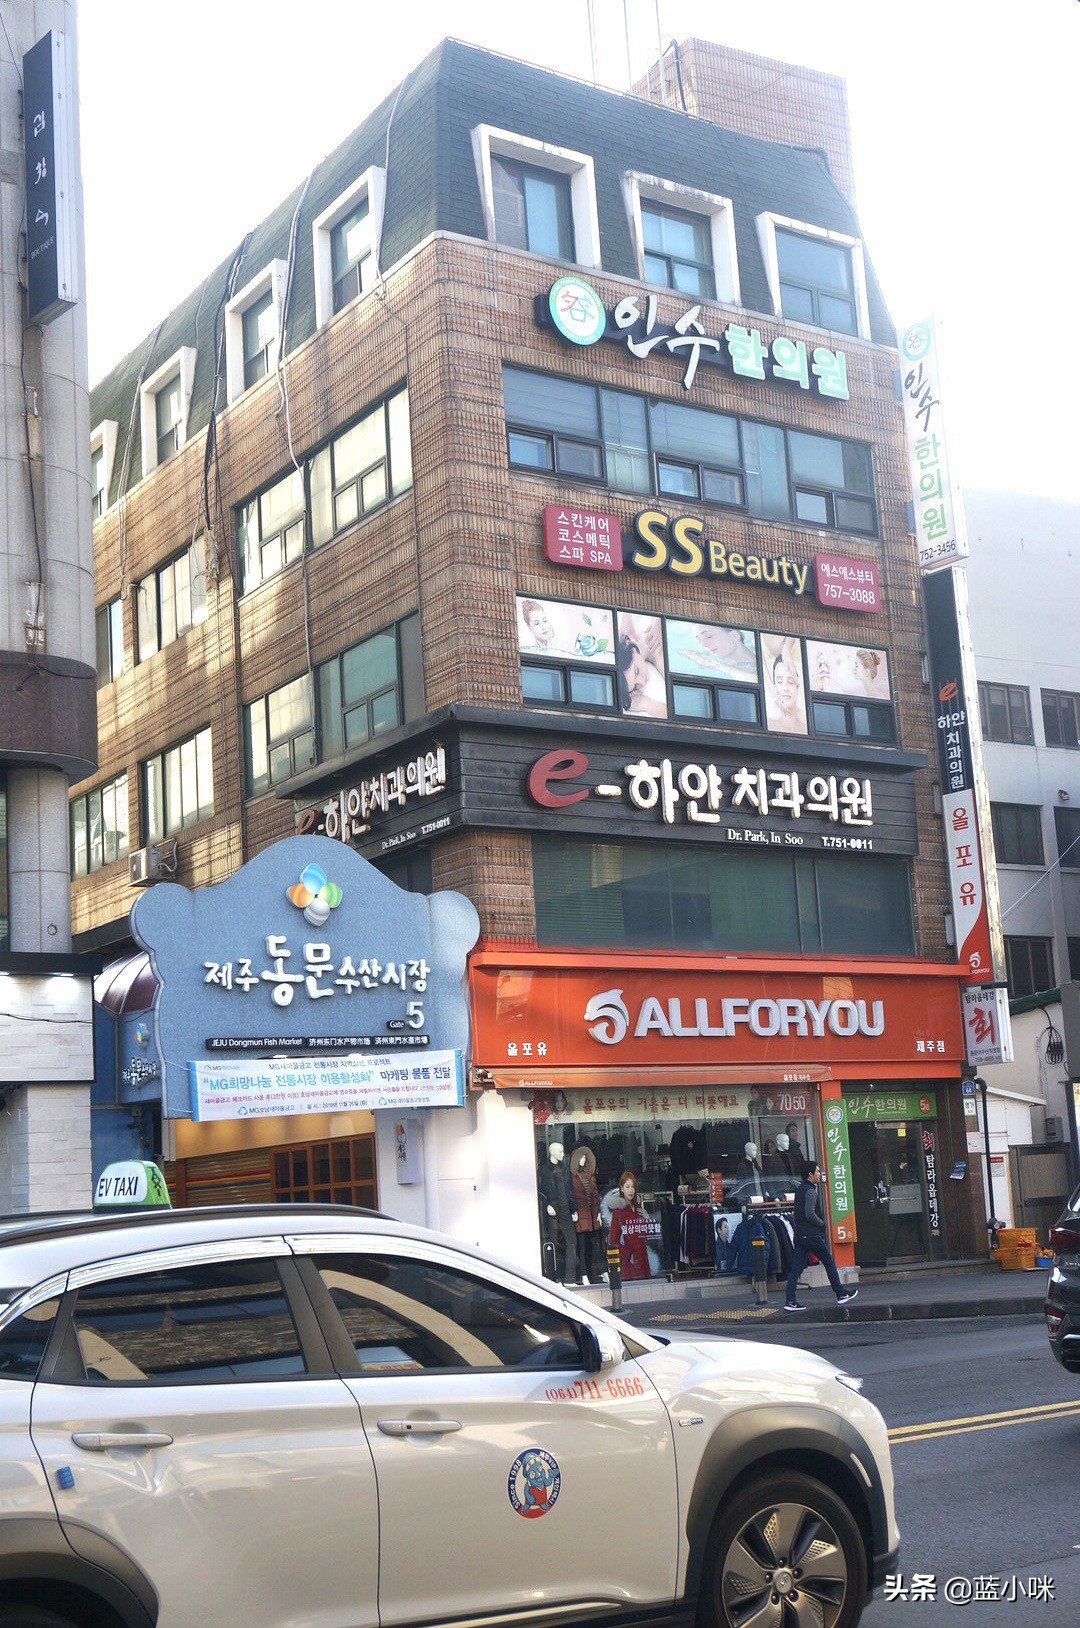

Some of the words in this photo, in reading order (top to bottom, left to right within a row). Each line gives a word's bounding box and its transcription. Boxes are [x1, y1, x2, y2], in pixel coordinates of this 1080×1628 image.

[614, 294, 849, 400] 인수한의원
[904, 362, 947, 541] 인수한의원
[557, 510, 609, 531] 스킨케어
[558, 528, 611, 550] 코스메틱
[559, 546, 585, 562] 스파
[590, 551, 612, 566] SPA
[632, 510, 706, 577] SS
[709, 540, 809, 596] Beauty
[919, 540, 956, 562] 752-3456
[821, 562, 874, 586] 에스에스뷰티
[823, 583, 876, 606] 757-3088
[937, 711, 967, 731] 하얀
[946, 731, 966, 790] 치과의원
[731, 765, 874, 826] 치과의원
[727, 828, 742, 841] Dr.
[744, 829, 769, 844] Park,
[770, 833, 780, 844] In
[784, 833, 804, 846] Soo
[951, 806, 977, 907] 올포유
[389, 1020, 405, 1029] Gate
[406, 1001, 425, 1029] 5
[634, 997, 885, 1038] ALLFORYOU
[968, 1007, 995, 1044] 회
[211, 1038, 227, 1047] JEJU
[229, 1037, 262, 1049] Dongmun
[264, 1037, 278, 1047] Fish
[279, 1036, 303, 1047] Market
[507, 1041, 548, 1056] 올포유
[916, 1039, 946, 1054] 제주점
[275, 1073, 317, 1088] 전통시장
[380, 1068, 409, 1081] 마케팅
[412, 1067, 431, 1080] 물품
[433, 1066, 451, 1080] 전달
[583, 1097, 629, 1115] 올포유의
[678, 1096, 688, 1109] 더
[827, 1127, 849, 1212] 인수한의원
[98, 1177, 112, 1197] EV
[113, 1176, 139, 1197] TAXI
